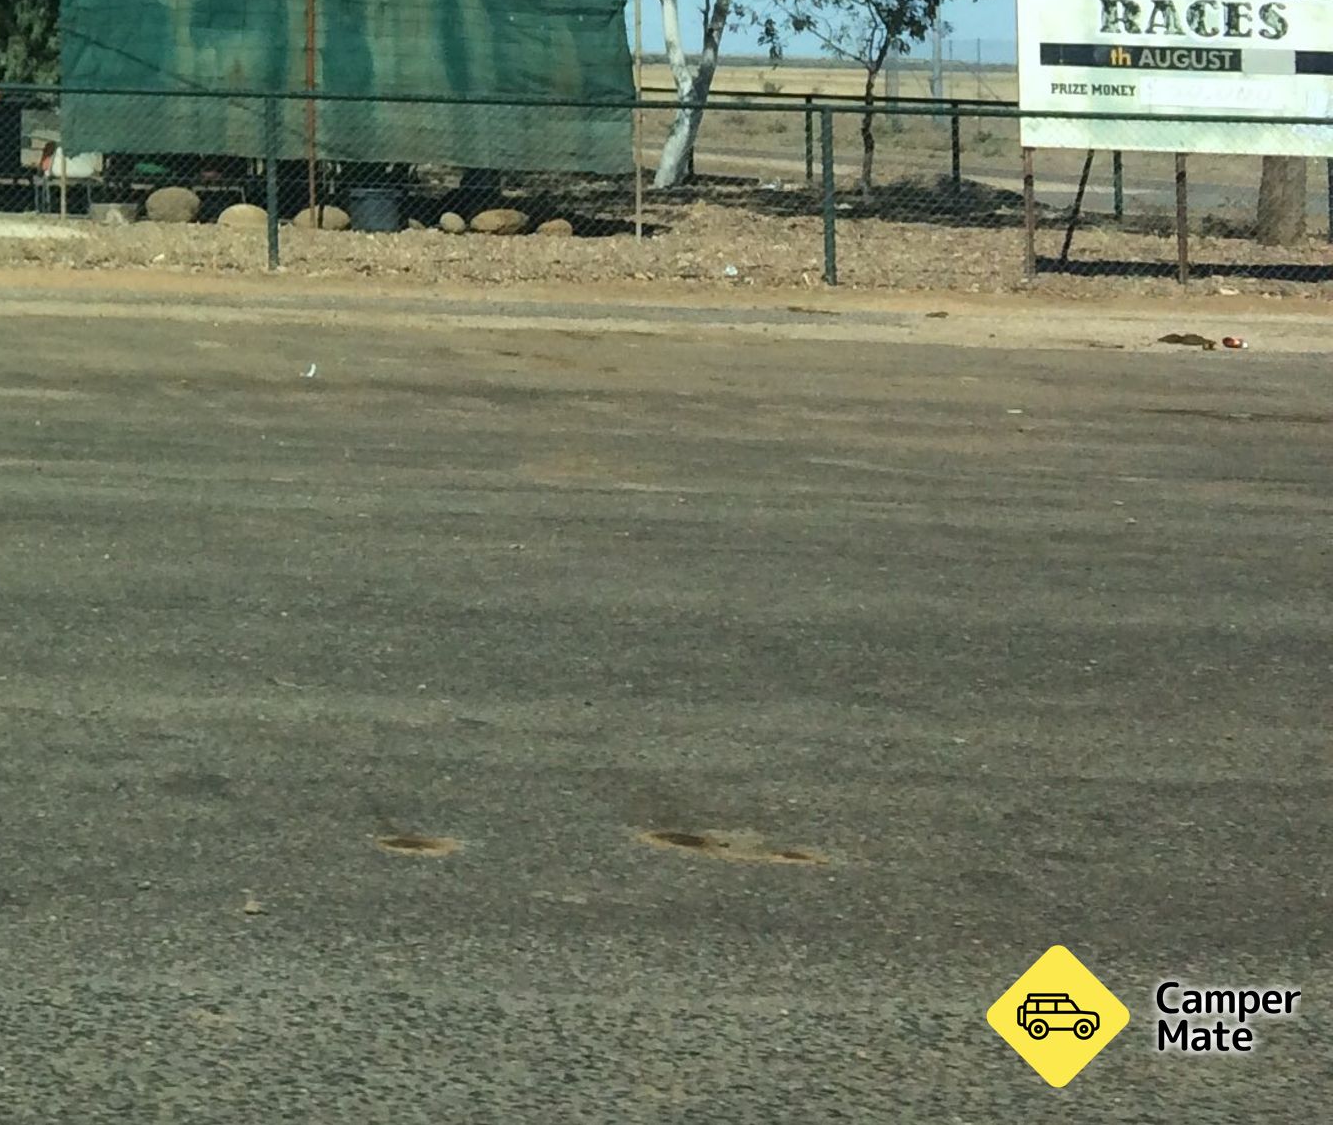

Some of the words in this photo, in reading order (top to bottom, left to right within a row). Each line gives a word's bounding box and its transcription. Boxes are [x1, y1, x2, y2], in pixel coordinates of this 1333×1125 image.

[1109, 46, 1132, 66] th
[1138, 49, 1234, 70] AUGUST
[1050, 82, 1088, 95] PRIZE
[1091, 84, 1137, 97] MONEY
